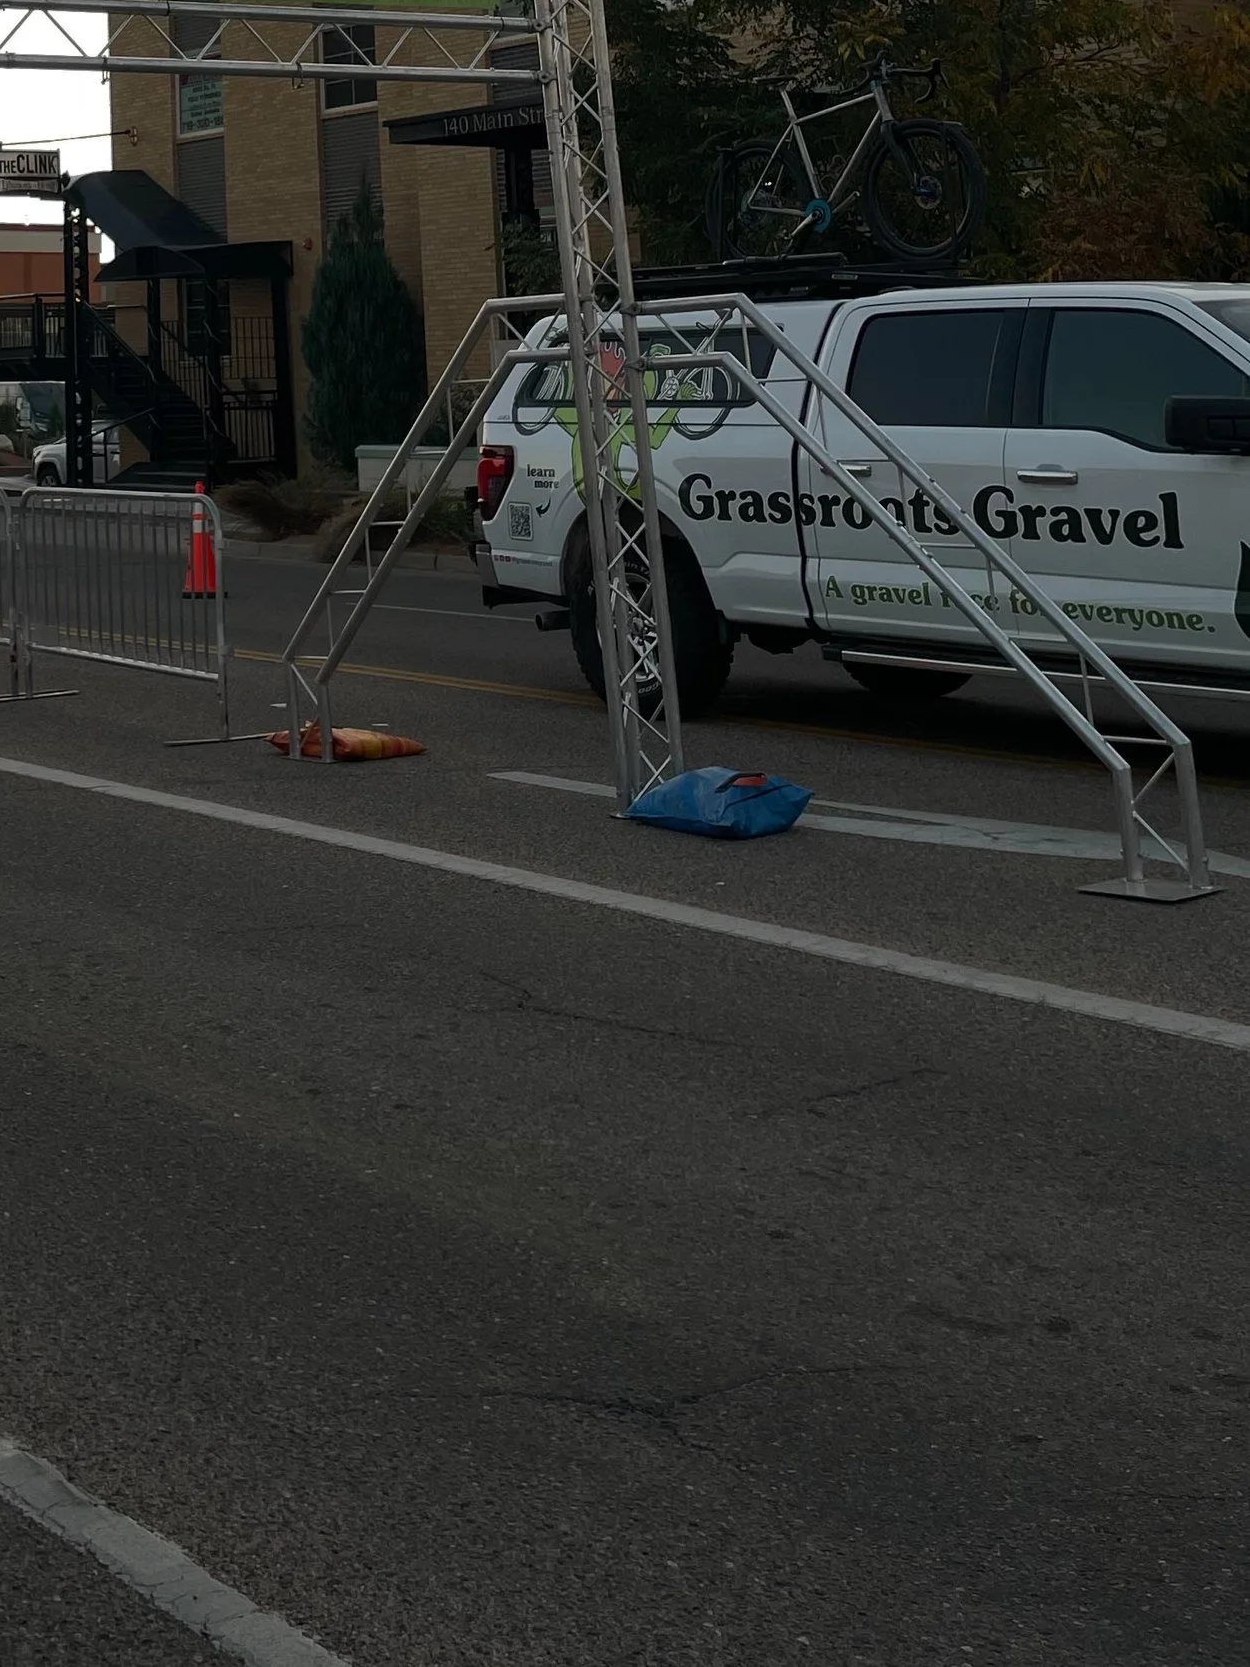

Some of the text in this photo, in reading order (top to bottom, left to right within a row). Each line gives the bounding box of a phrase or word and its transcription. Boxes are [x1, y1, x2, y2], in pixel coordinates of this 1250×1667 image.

[443, 105, 546, 136] 140 Main Str
[16, 154, 58, 175] CLINK
[526, 464, 556, 477] learn
[534, 480, 560, 489] more
[972, 484, 1185, 549] Gravel
[825, 575, 1216, 634] A gravel rce fo everyone.
